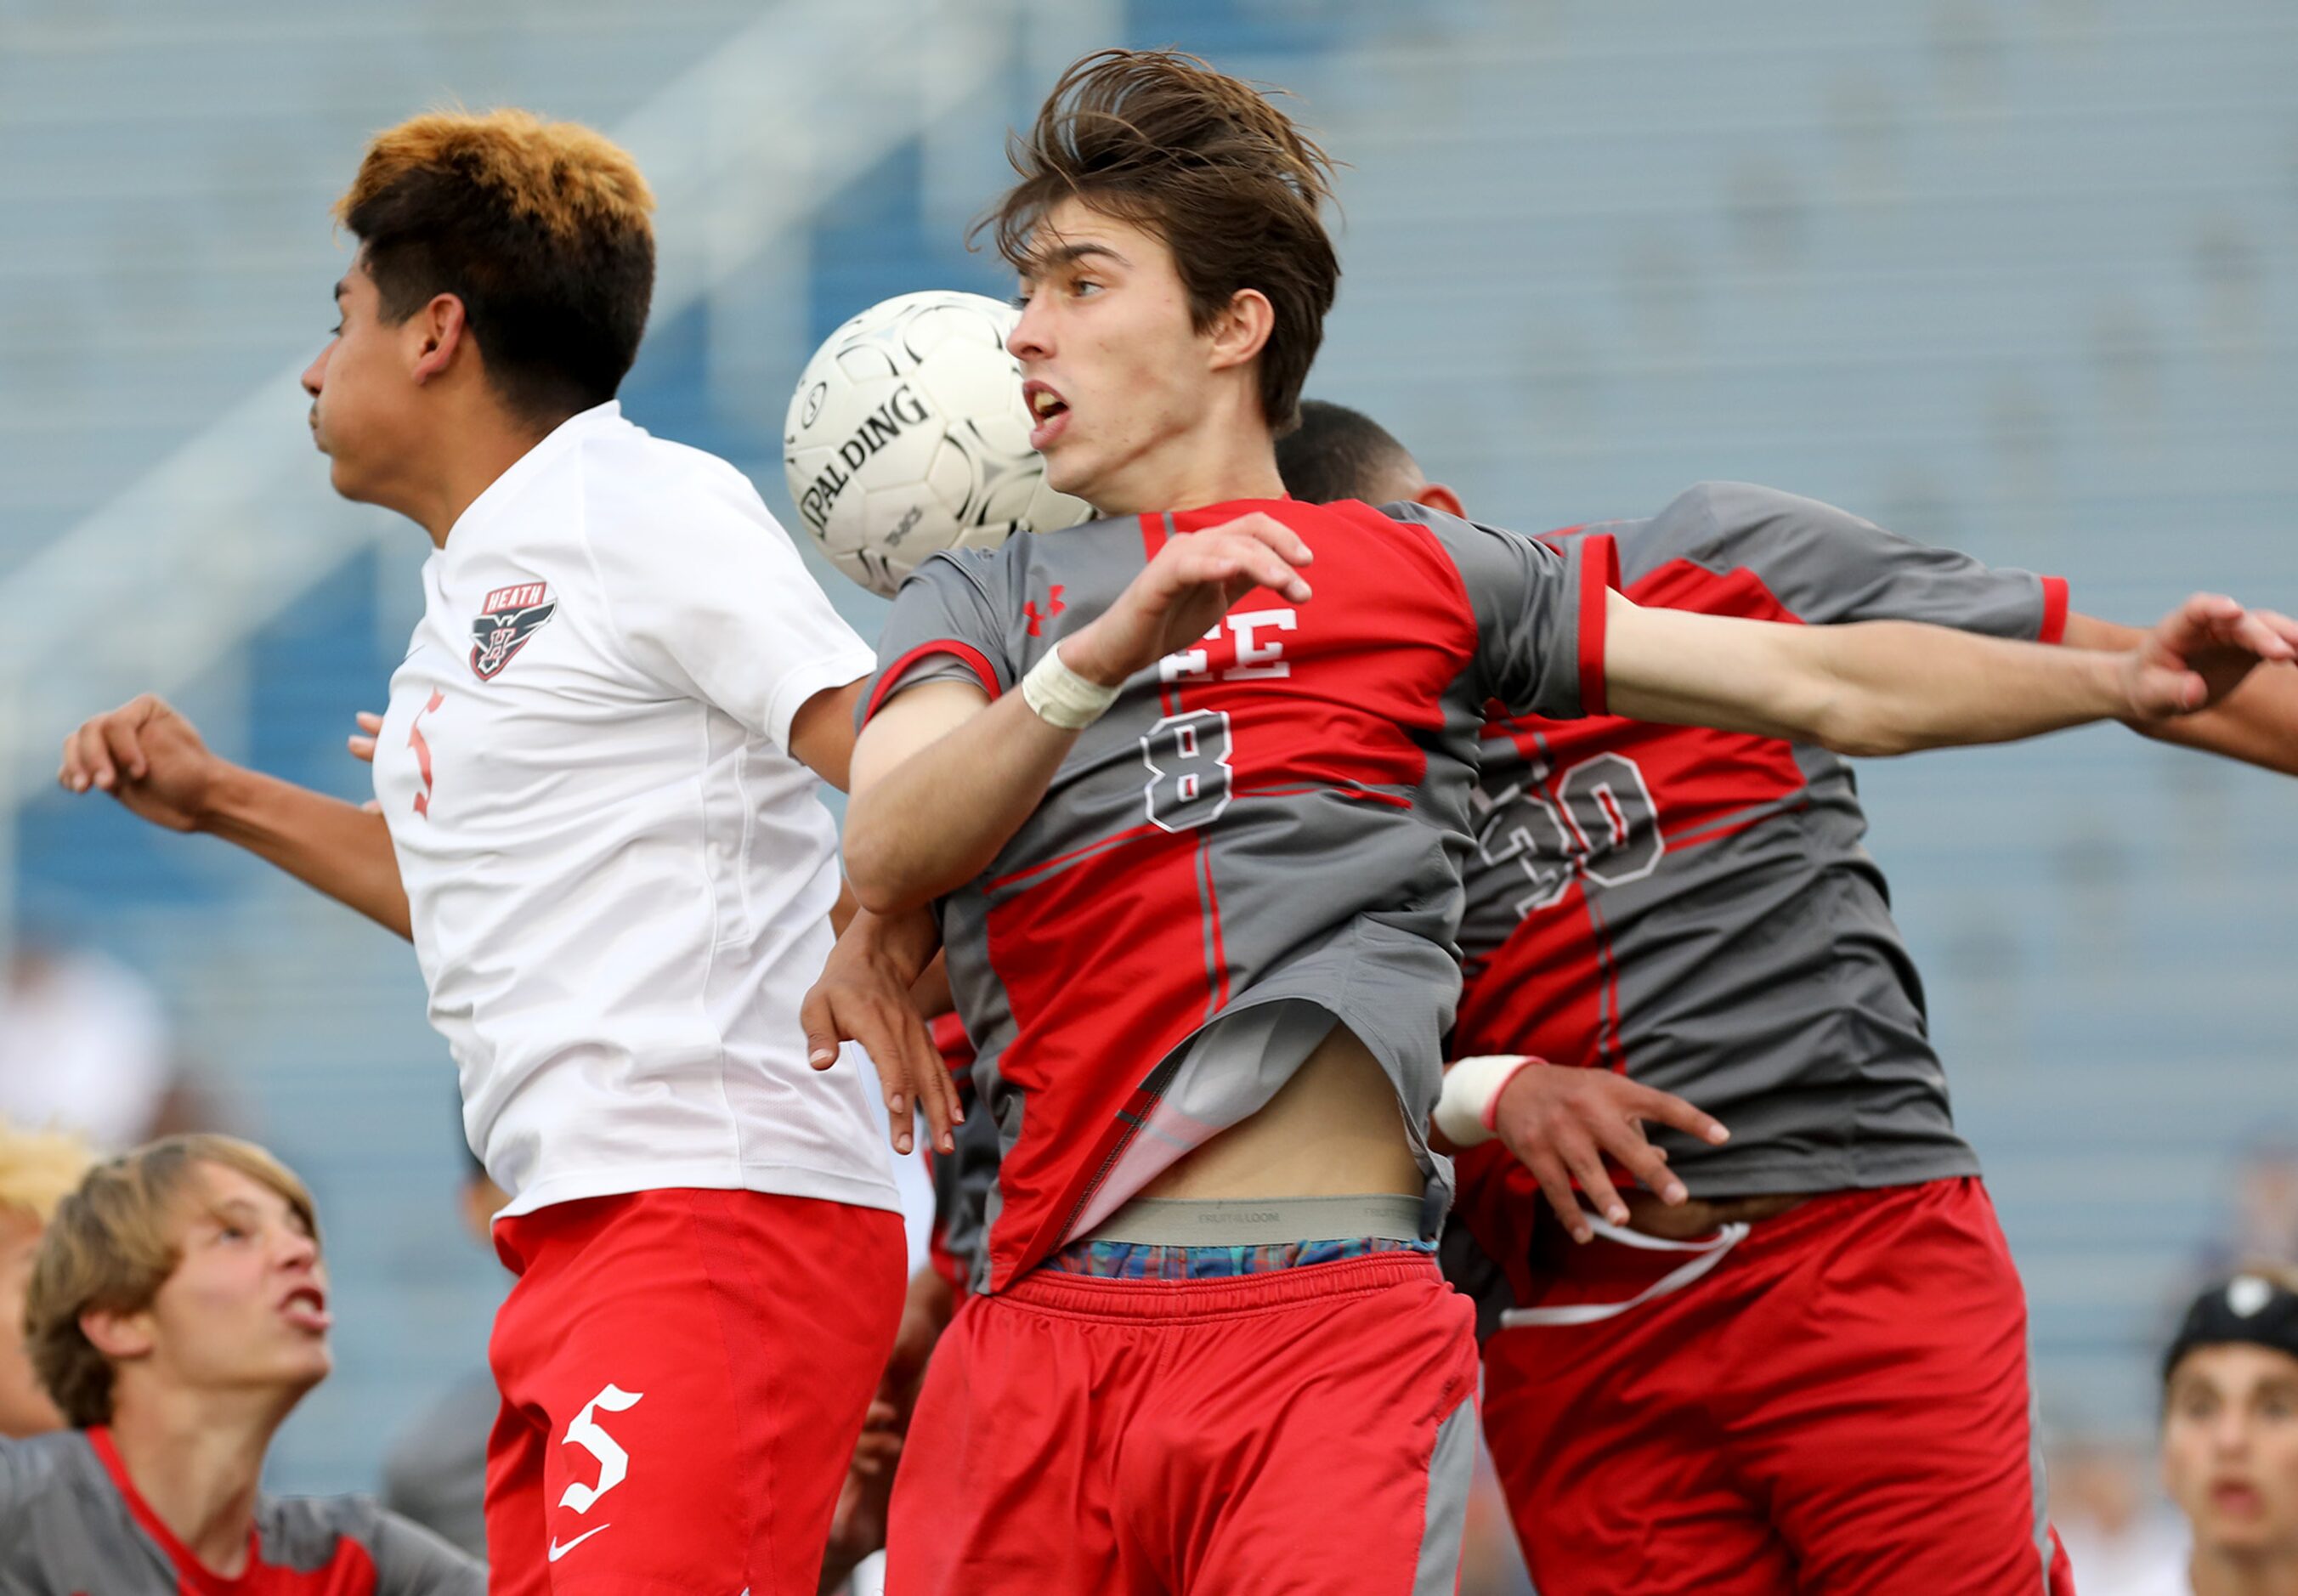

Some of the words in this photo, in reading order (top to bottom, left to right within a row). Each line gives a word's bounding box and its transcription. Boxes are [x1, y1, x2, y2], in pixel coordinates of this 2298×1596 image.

[487, 584, 542, 612] HEATH
[406, 685, 445, 821] 5
[1140, 709, 1233, 833] 8
[558, 1383, 643, 1514] 5
